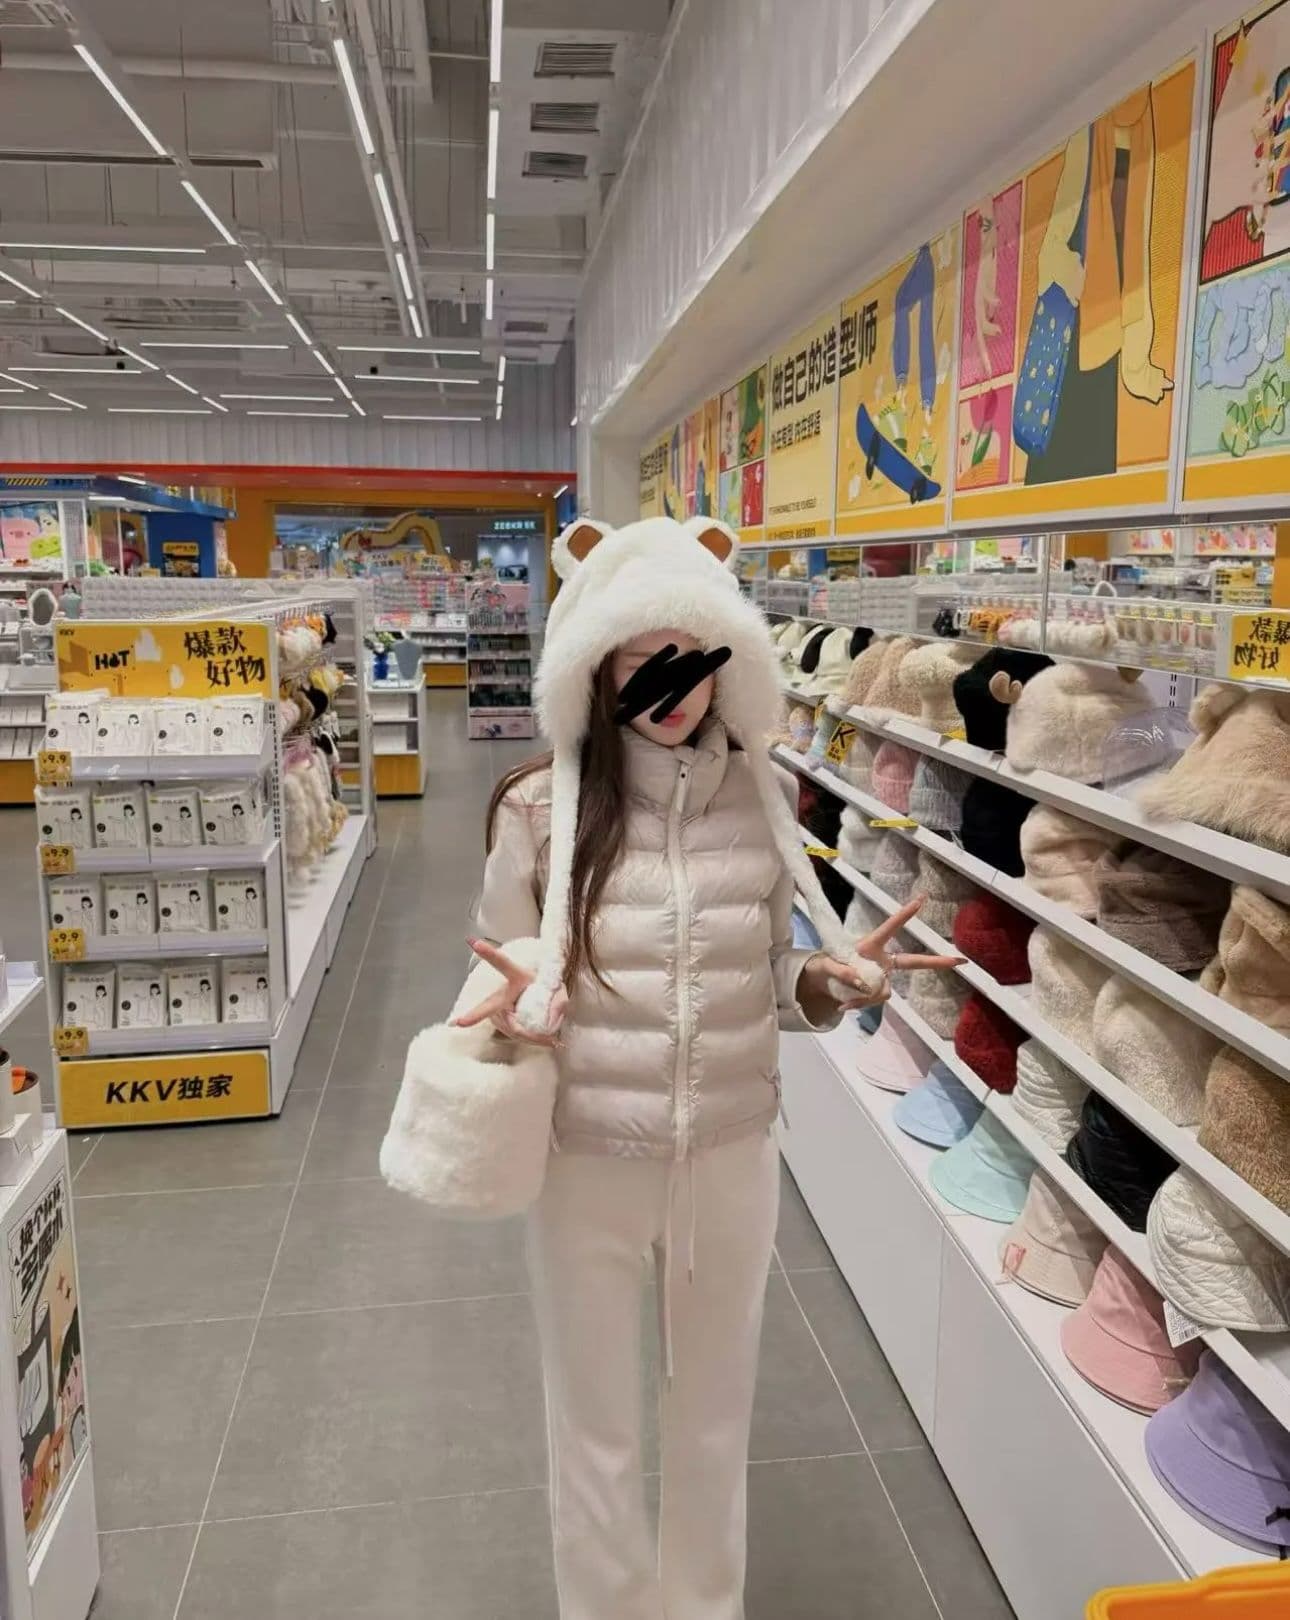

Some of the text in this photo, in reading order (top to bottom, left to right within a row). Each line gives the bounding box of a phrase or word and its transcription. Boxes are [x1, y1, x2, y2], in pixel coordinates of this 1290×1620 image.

[773, 299, 878, 414] 做自己的造型师
[184, 626, 246, 659] 爆款
[95, 650, 130, 670] HOT
[207, 655, 265, 688] 好物
[106, 1074, 233, 1104] KKV独家
